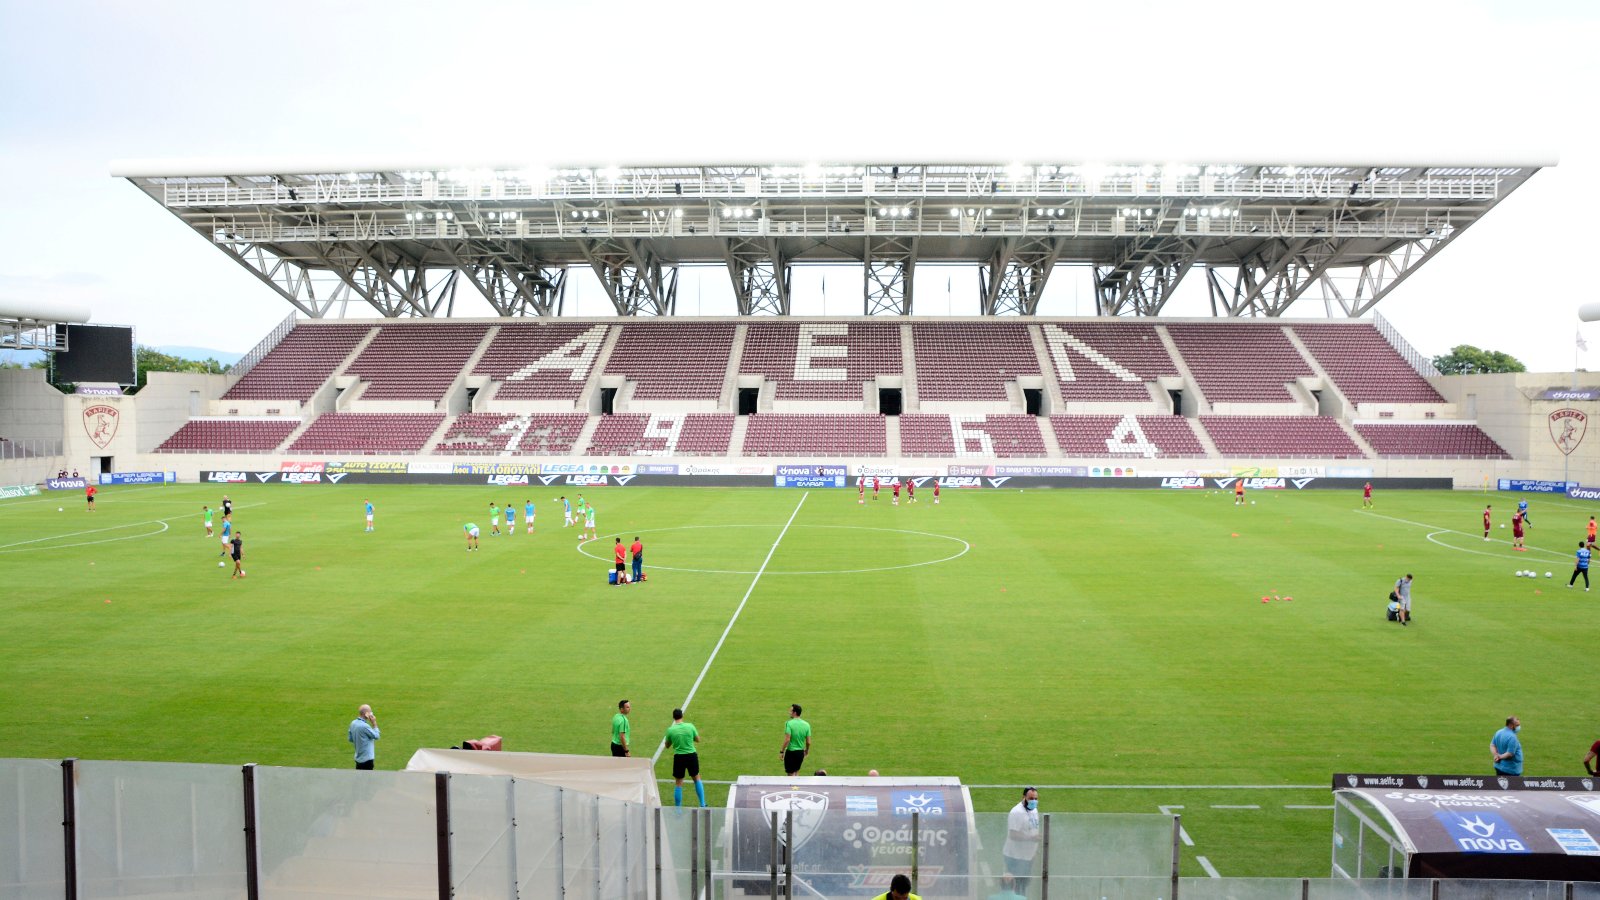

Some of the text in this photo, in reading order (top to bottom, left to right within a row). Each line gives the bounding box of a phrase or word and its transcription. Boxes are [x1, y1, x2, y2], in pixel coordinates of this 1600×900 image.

[543, 464, 584, 472] LEGEA
[960, 466, 983, 476] Bayer
[208, 472, 247, 481] LEGEA
[281, 472, 321, 481] LEGEA
[487, 475, 529, 484] LEGEA
[566, 475, 608, 484] LEGEA
[60, 480, 85, 489] nova
[938, 477, 982, 486] LEGEA
[1161, 478, 1205, 487] LEGEA
[1243, 478, 1286, 487] LEGEA
[1580, 490, 1600, 499] nov
[895, 806, 943, 815] nova
[1458, 837, 1526, 851] nova
[871, 843, 926, 857] γεύσες
